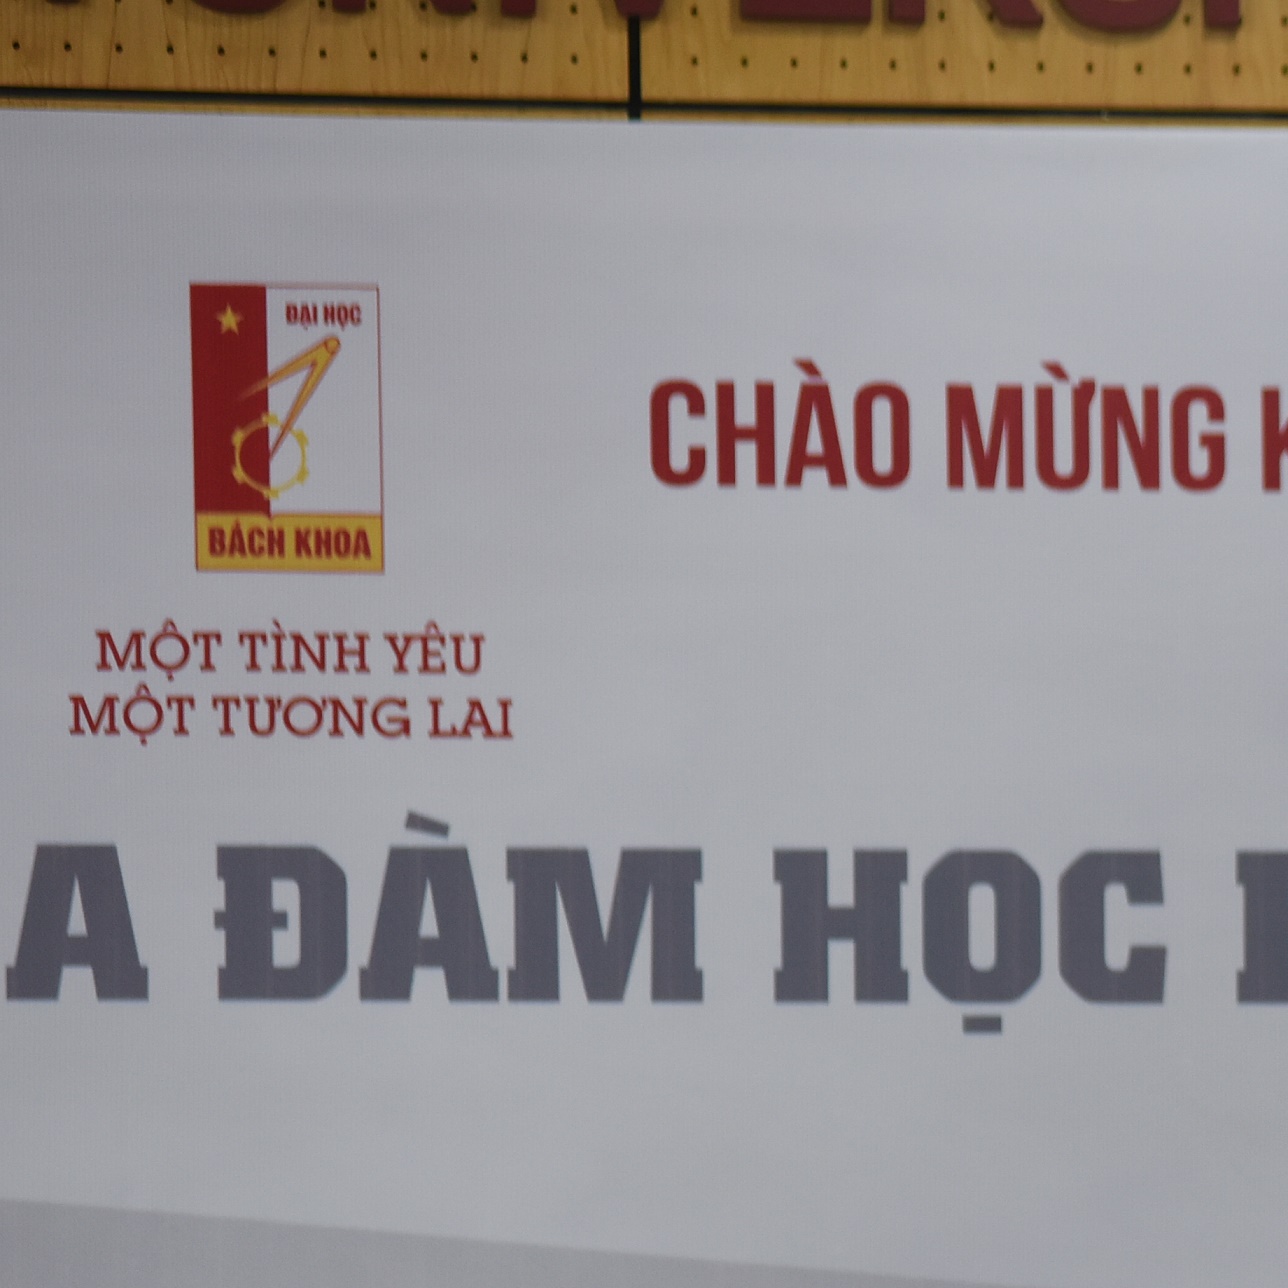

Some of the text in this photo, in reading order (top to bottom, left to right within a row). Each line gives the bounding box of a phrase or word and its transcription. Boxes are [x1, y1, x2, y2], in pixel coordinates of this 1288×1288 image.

[285, 303, 362, 331] ĐẠI HỌC
[649, 358, 911, 489] CHÀO
[945, 361, 1226, 492] MỪNG
[208, 519, 372, 560] BÁCH KHOA
[95, 618, 485, 682] MỘT TÌNH YÊU
[69, 683, 513, 746] MỘT TƯƠNG LAI
[5, 843, 150, 1003] A
[213, 810, 704, 1005] ĐÀM
[773, 847, 1168, 1036] HỌC
